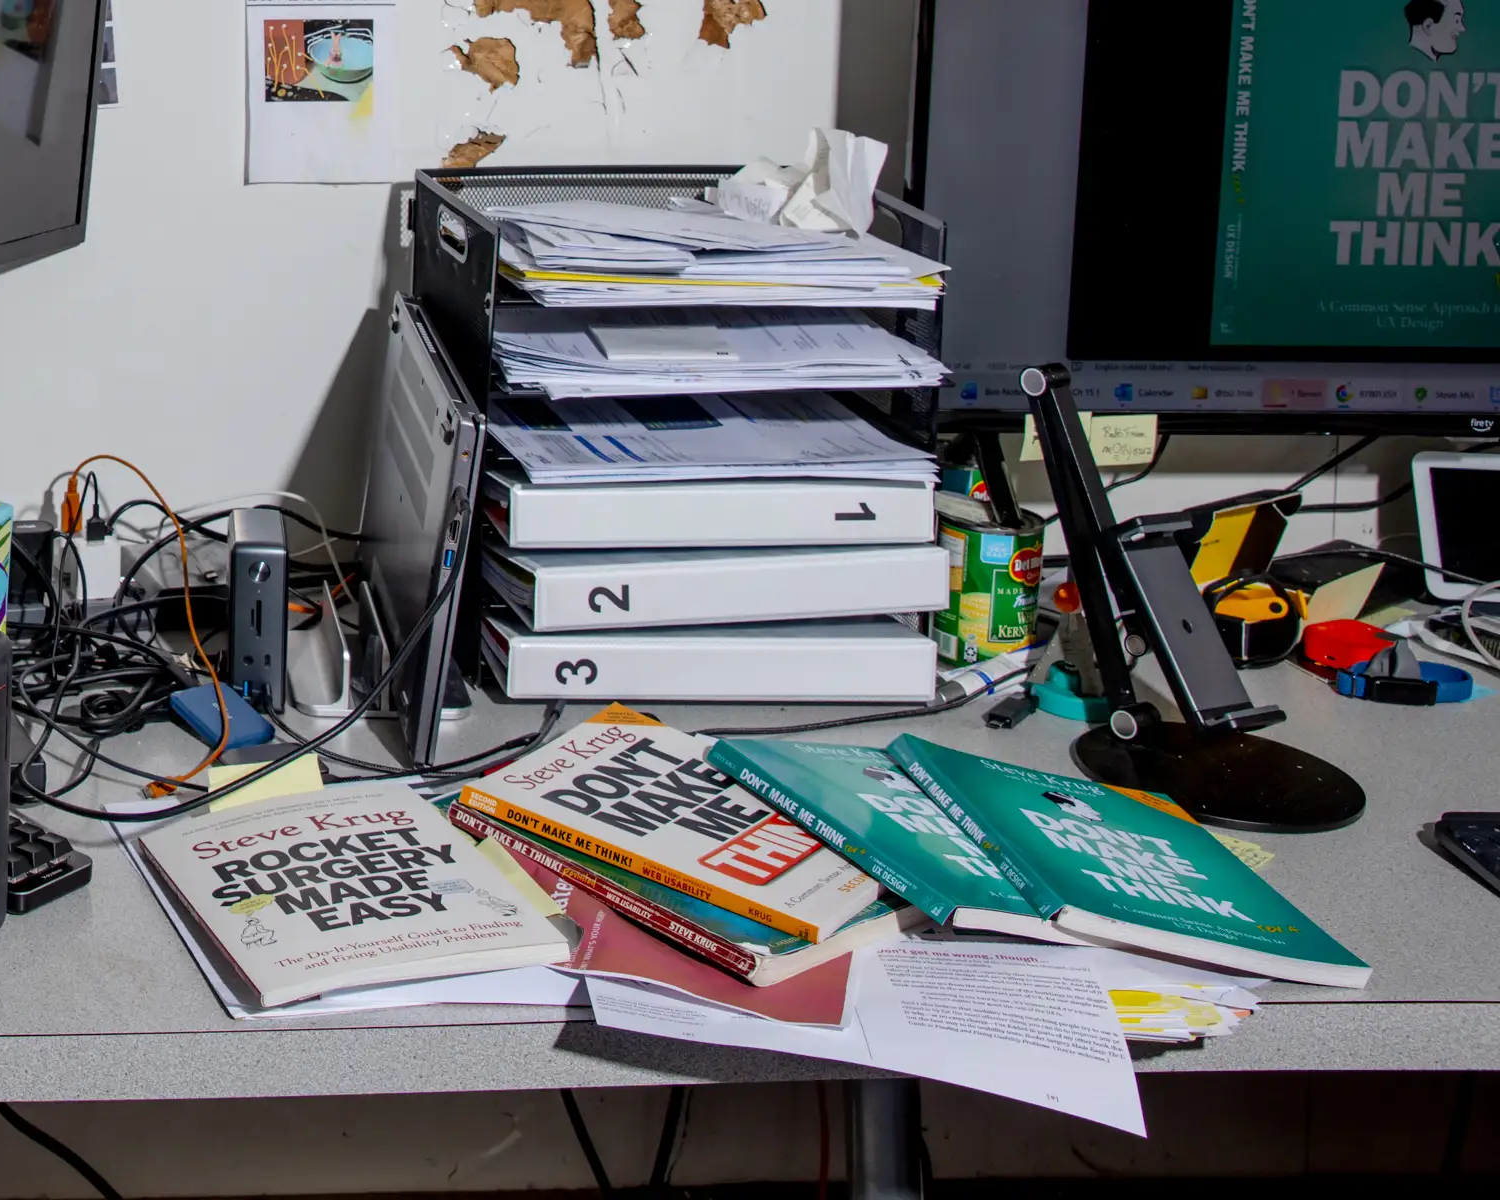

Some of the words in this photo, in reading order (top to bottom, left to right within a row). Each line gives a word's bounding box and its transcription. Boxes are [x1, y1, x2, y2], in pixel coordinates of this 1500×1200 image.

[1237, 35, 1254, 85] MAKE
[1235, 90, 1251, 117] ME
[1231, 121, 1249, 172] THINK
[1376, 172, 1466, 217] ME
[1329, 221, 1500, 267] THINK
[1329, 302, 1389, 314] Common
[1391, 301, 1427, 314] Sense
[1430, 302, 1491, 316] Approach
[1400, 316, 1444, 331] Design
[1138, 388, 1174, 397] Calendar
[834, 502, 876, 521] 1
[588, 584, 630, 614] 2
[555, 658, 598, 686] 3
[503, 755, 576, 790] Steve
[560, 725, 637, 760] Krug
[540, 738, 684, 816] DON'T
[978, 758, 1038, 779] Steve
[1041, 773, 1106, 797] Krug
[468, 800, 497, 815] EDITION
[469, 791, 498, 807] SECOND
[590, 758, 737, 837] MAKE
[674, 795, 772, 842] ME
[740, 767, 769, 794] DON'T
[769, 787, 798, 816] MAKE
[798, 807, 816, 828] ME
[815, 819, 847, 849] THINK
[907, 761, 934, 786] DON'T
[928, 780, 954, 808] MAKE
[948, 802, 965, 821] ME
[960, 815, 987, 845] THINK
[192, 824, 302, 860] Steve
[306, 809, 415, 832] Krug
[456, 809, 485, 832] DON'T
[485, 825, 516, 850] MAKE
[512, 841, 529, 856] ME
[529, 846, 563, 873] THINK!
[506, 809, 540, 830] DON'T
[541, 820, 573, 843] MAKE
[575, 833, 592, 851] ME
[594, 843, 633, 868] THINK!
[1019, 807, 1183, 858] DON'T
[1040, 828, 1208, 881] MAKE
[212, 827, 422, 884] ROCKET
[212, 844, 456, 907] SURGERY
[1101, 855, 1194, 893] ME
[275, 868, 432, 916] MADE
[641, 865, 663, 881] WEB
[663, 872, 712, 901] USABILITY
[870, 864, 882, 878] UX
[879, 870, 907, 893] DESIGN
[1080, 868, 1256, 923] THINK
[306, 893, 448, 932] EASY
[605, 891, 621, 906] WEB
[619, 898, 652, 920] USABILITY
[747, 906, 773, 924] KRUG
[275, 955, 304, 969] The
[307, 934, 404, 960] Do-It-Yourself
[407, 927, 450, 940] Guide
[452, 924, 467, 933] to
[469, 919, 524, 935] Finding
[304, 959, 330, 971] and
[332, 950, 378, 964] Fixing
[379, 938, 441, 955] Usability
[444, 931, 508, 944] Problems
[668, 920, 694, 940] STEVE
[693, 931, 718, 952] KRUG
[910, 949, 928, 958] get
[952, 952, 993, 961] wrong,
[994, 953, 1040, 964] though
